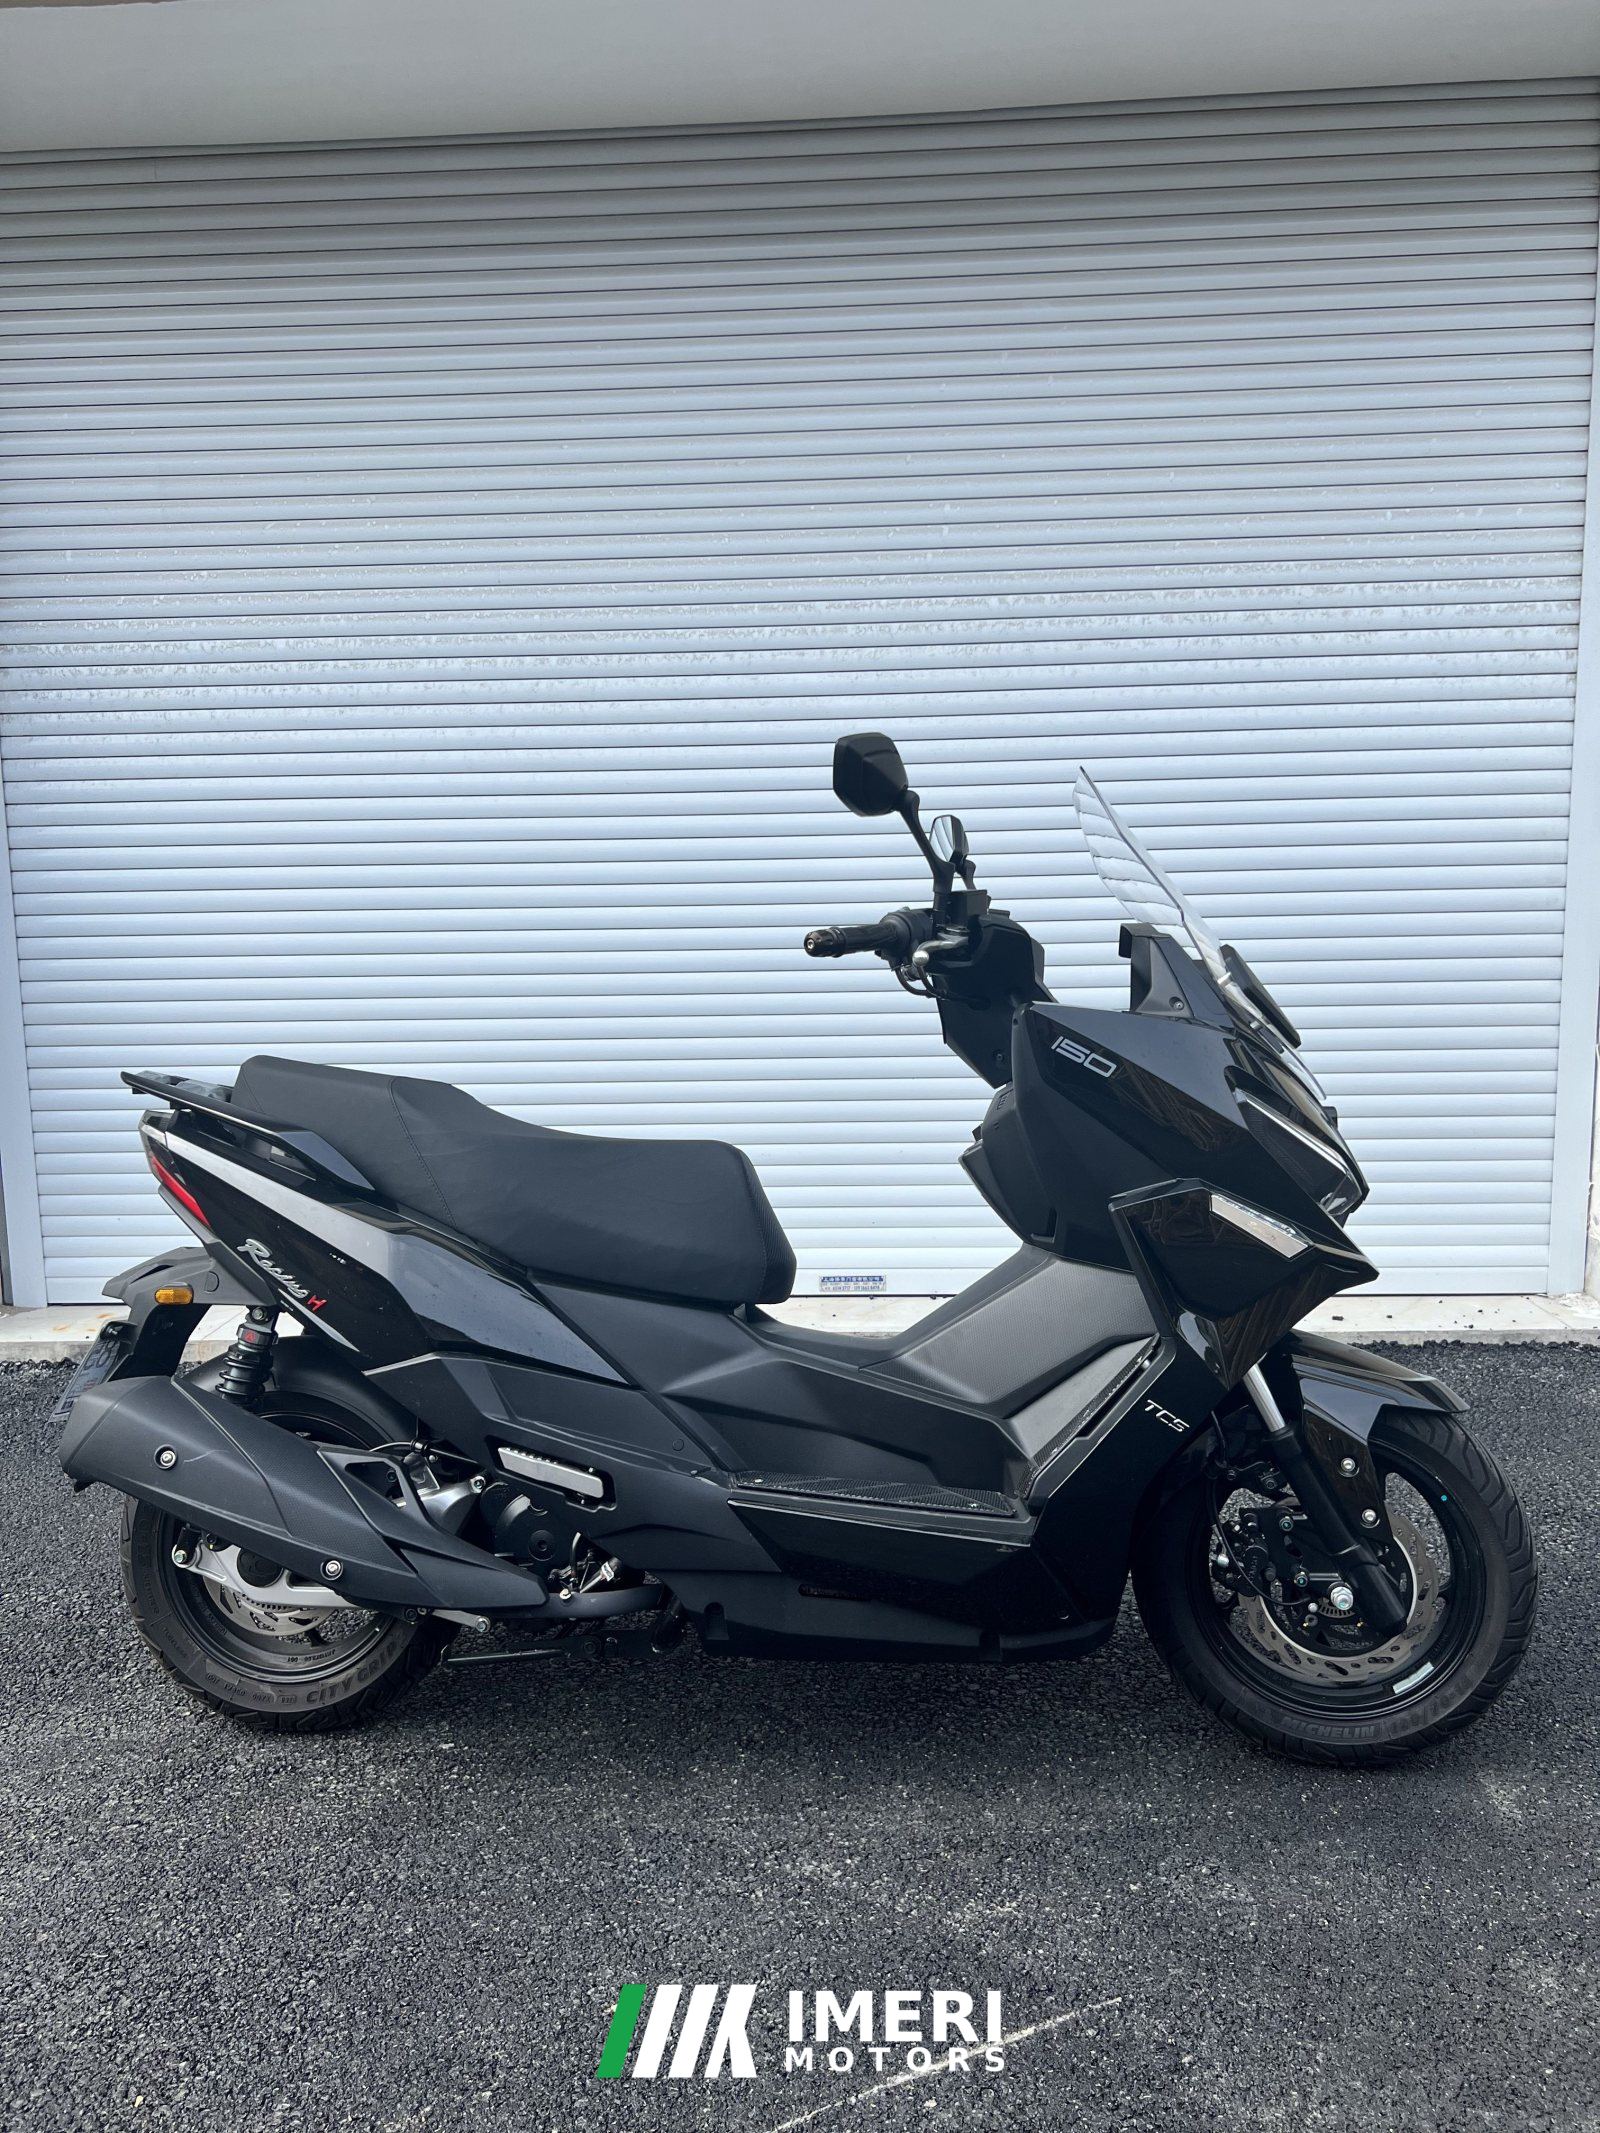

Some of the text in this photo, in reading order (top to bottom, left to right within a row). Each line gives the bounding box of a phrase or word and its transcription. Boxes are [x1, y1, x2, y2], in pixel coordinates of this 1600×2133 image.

[1051, 1036, 1117, 1077] 150
[236, 1239, 310, 1299] Racing
[1144, 1399, 1190, 1432] TCS
[306, 1677, 353, 1703] CITY
[1280, 1716, 1376, 1739] MICHELIN
